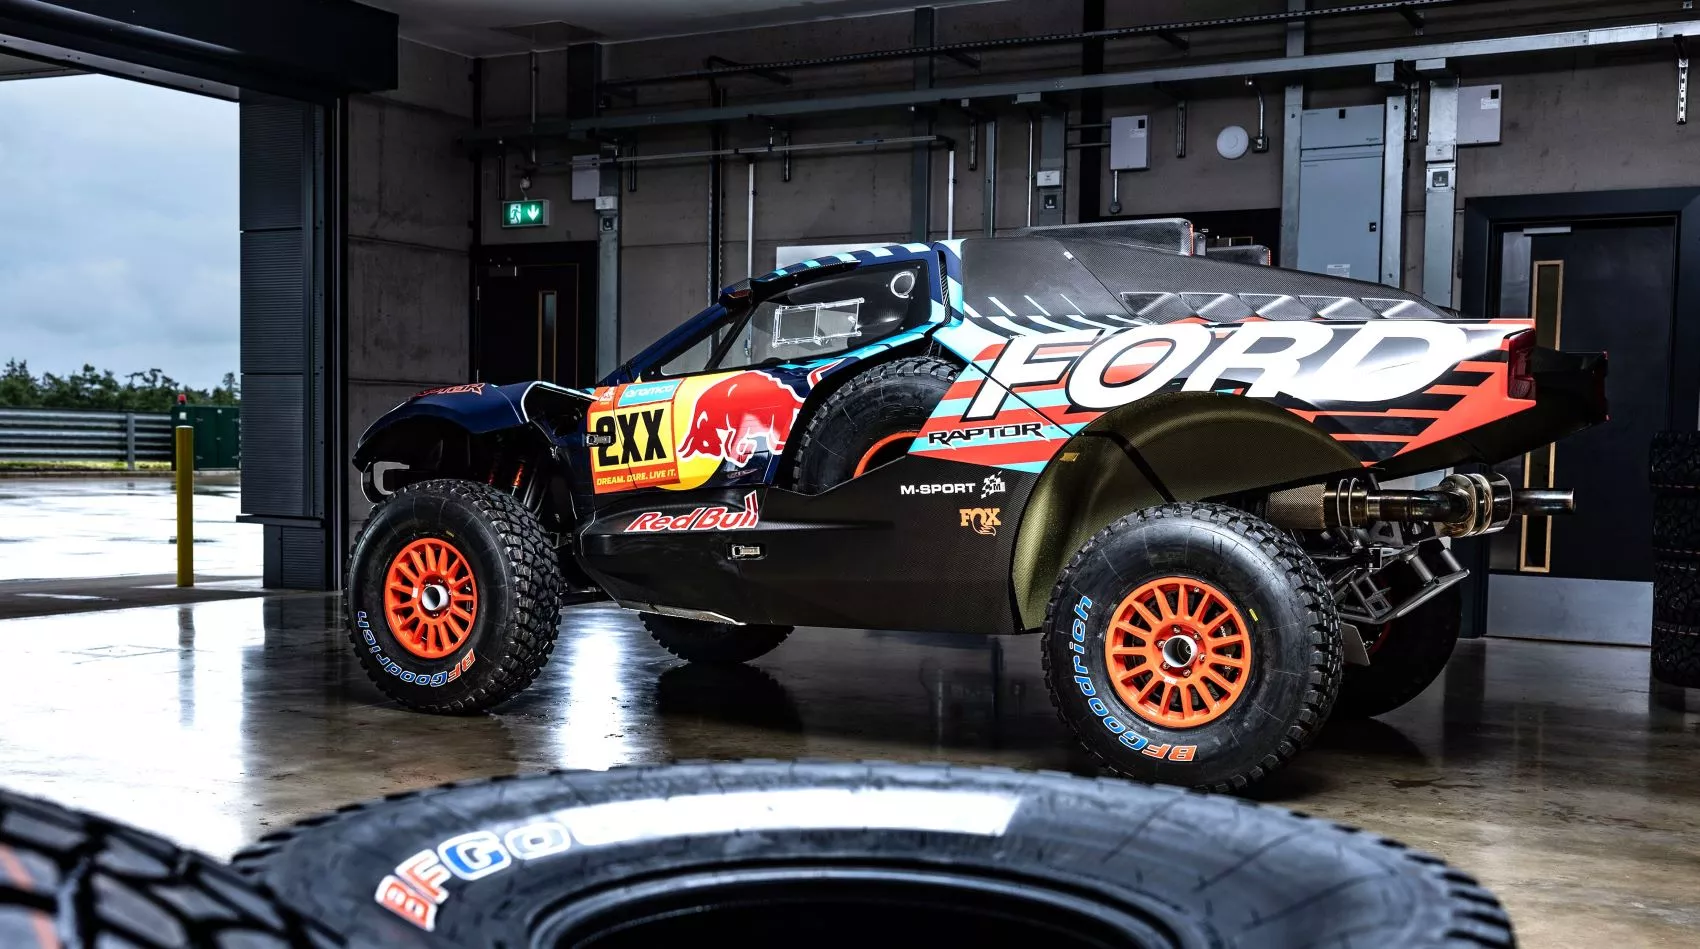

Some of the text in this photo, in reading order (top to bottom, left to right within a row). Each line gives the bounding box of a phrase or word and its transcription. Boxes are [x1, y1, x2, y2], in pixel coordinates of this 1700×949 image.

[962, 320, 1466, 421] FORD
[626, 385, 675, 398] aramco
[595, 408, 667, 467] 2XX
[927, 422, 1050, 450] RAPTOR
[596, 469, 676, 486] DREAM. DARE. LIVE IT.
[900, 483, 976, 495] M-SPORT
[624, 490, 759, 532] Red Bull
[959, 507, 1001, 535] FOX
[357, 610, 476, 688] BFGoodrich
[1072, 595, 1198, 762] BFGoodrich
